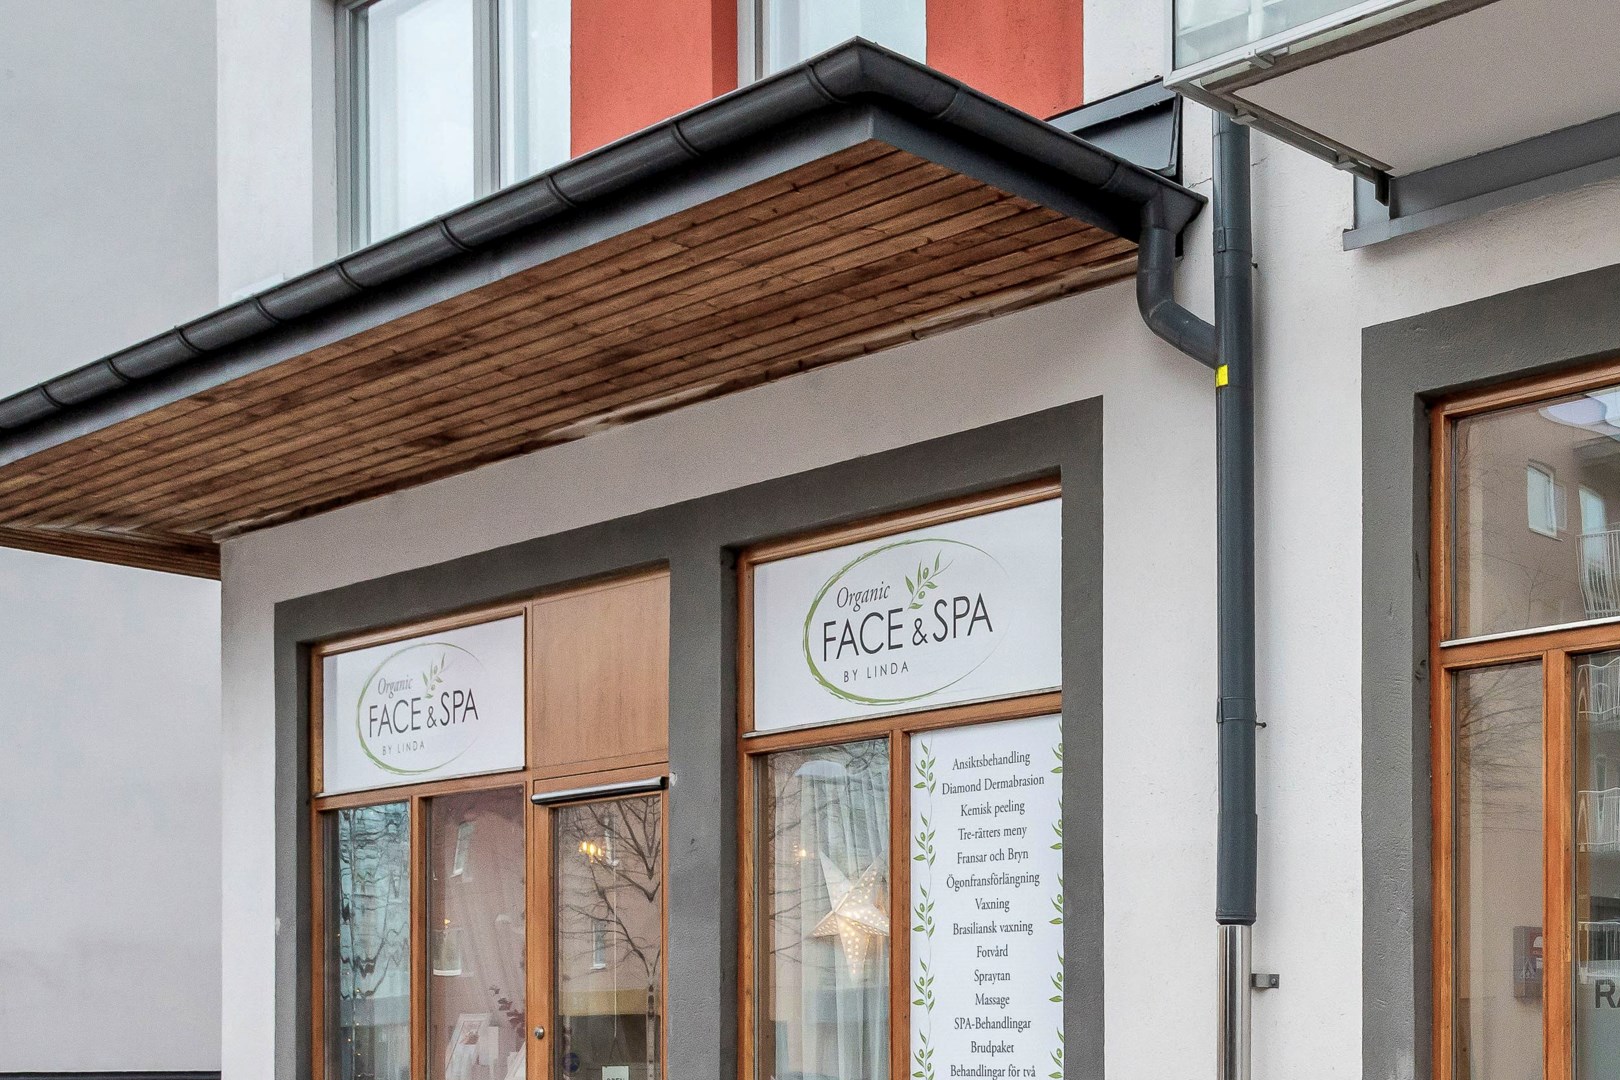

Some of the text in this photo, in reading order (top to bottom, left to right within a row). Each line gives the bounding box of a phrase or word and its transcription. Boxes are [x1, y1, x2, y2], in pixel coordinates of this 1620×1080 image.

[836, 580, 891, 613] Organic
[823, 592, 994, 662] FACE & SPA
[843, 661, 909, 683] BY LINDA
[377, 674, 414, 699] Organic
[369, 688, 479, 738] FACE & SPA
[382, 740, 425, 756] BY LINDA
[952, 751, 1031, 771] Ansiktsbehandling
[942, 775, 1045, 795] Diamond Dermabrasion
[960, 801, 1026, 817] Kemisk peeling
[958, 826, 1028, 841] Tre-rätters meny
[957, 848, 1029, 865] Fransar och Bryn
[946, 872, 1040, 892] Ögonfransförlängning
[975, 898, 1010, 912] Vaxning
[953, 922, 1033, 936] Brasiliansk vaxning
[976, 944, 1008, 958] Fotvård
[974, 969, 1011, 984] Spraytan
[975, 994, 1010, 1009] Massage
[954, 1017, 1031, 1032] SPA-Behandlingar
[971, 1041, 1014, 1056] Brudpaket
[950, 1065, 1036, 1079] Behandlingar för två
